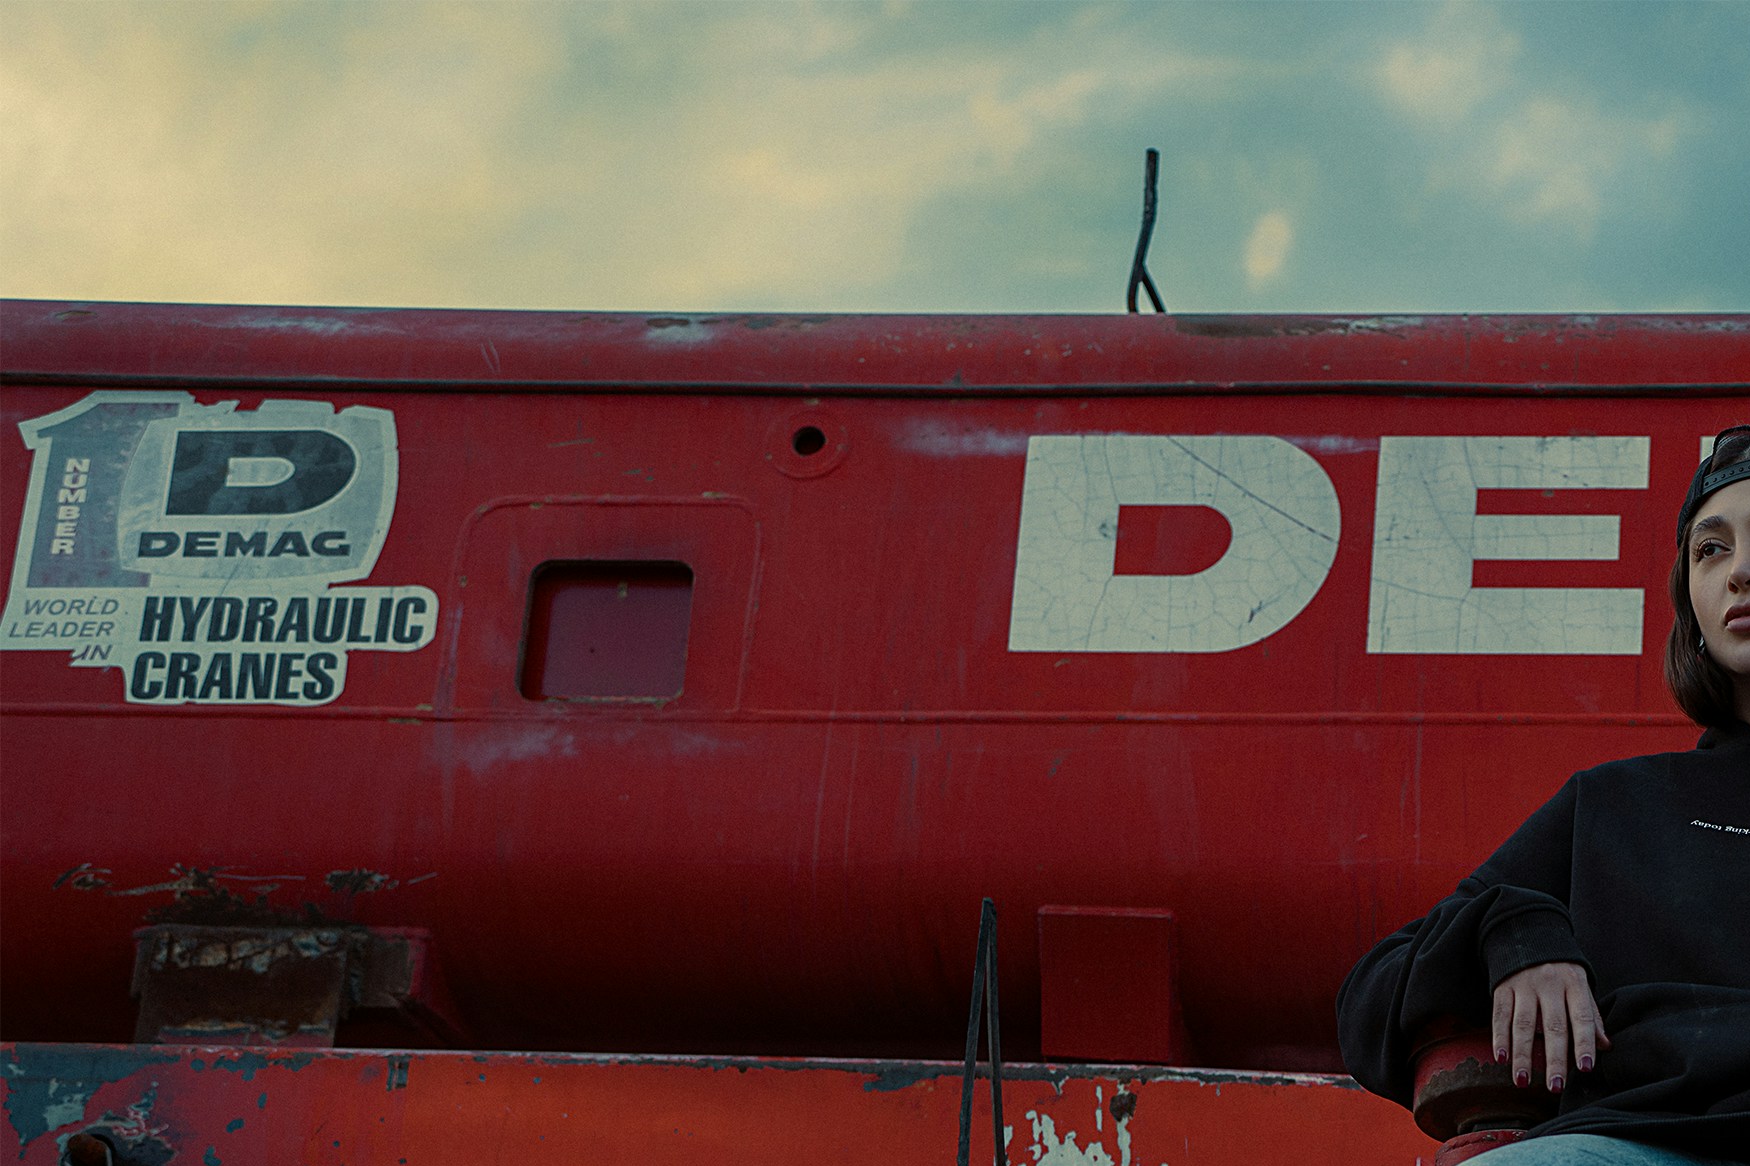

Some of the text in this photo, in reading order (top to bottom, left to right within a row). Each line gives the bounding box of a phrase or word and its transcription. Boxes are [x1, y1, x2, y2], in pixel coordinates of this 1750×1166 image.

[51, 458, 91, 555] NUMBER
[138, 531, 351, 558] DEMAG
[25, 598, 120, 615] WORLD
[9, 621, 115, 638] LEADER
[139, 596, 428, 644] HYDRAULIC
[80, 644, 113, 661] IN
[131, 651, 339, 701] CRANES
[1690, 819, 1722, 831] today
